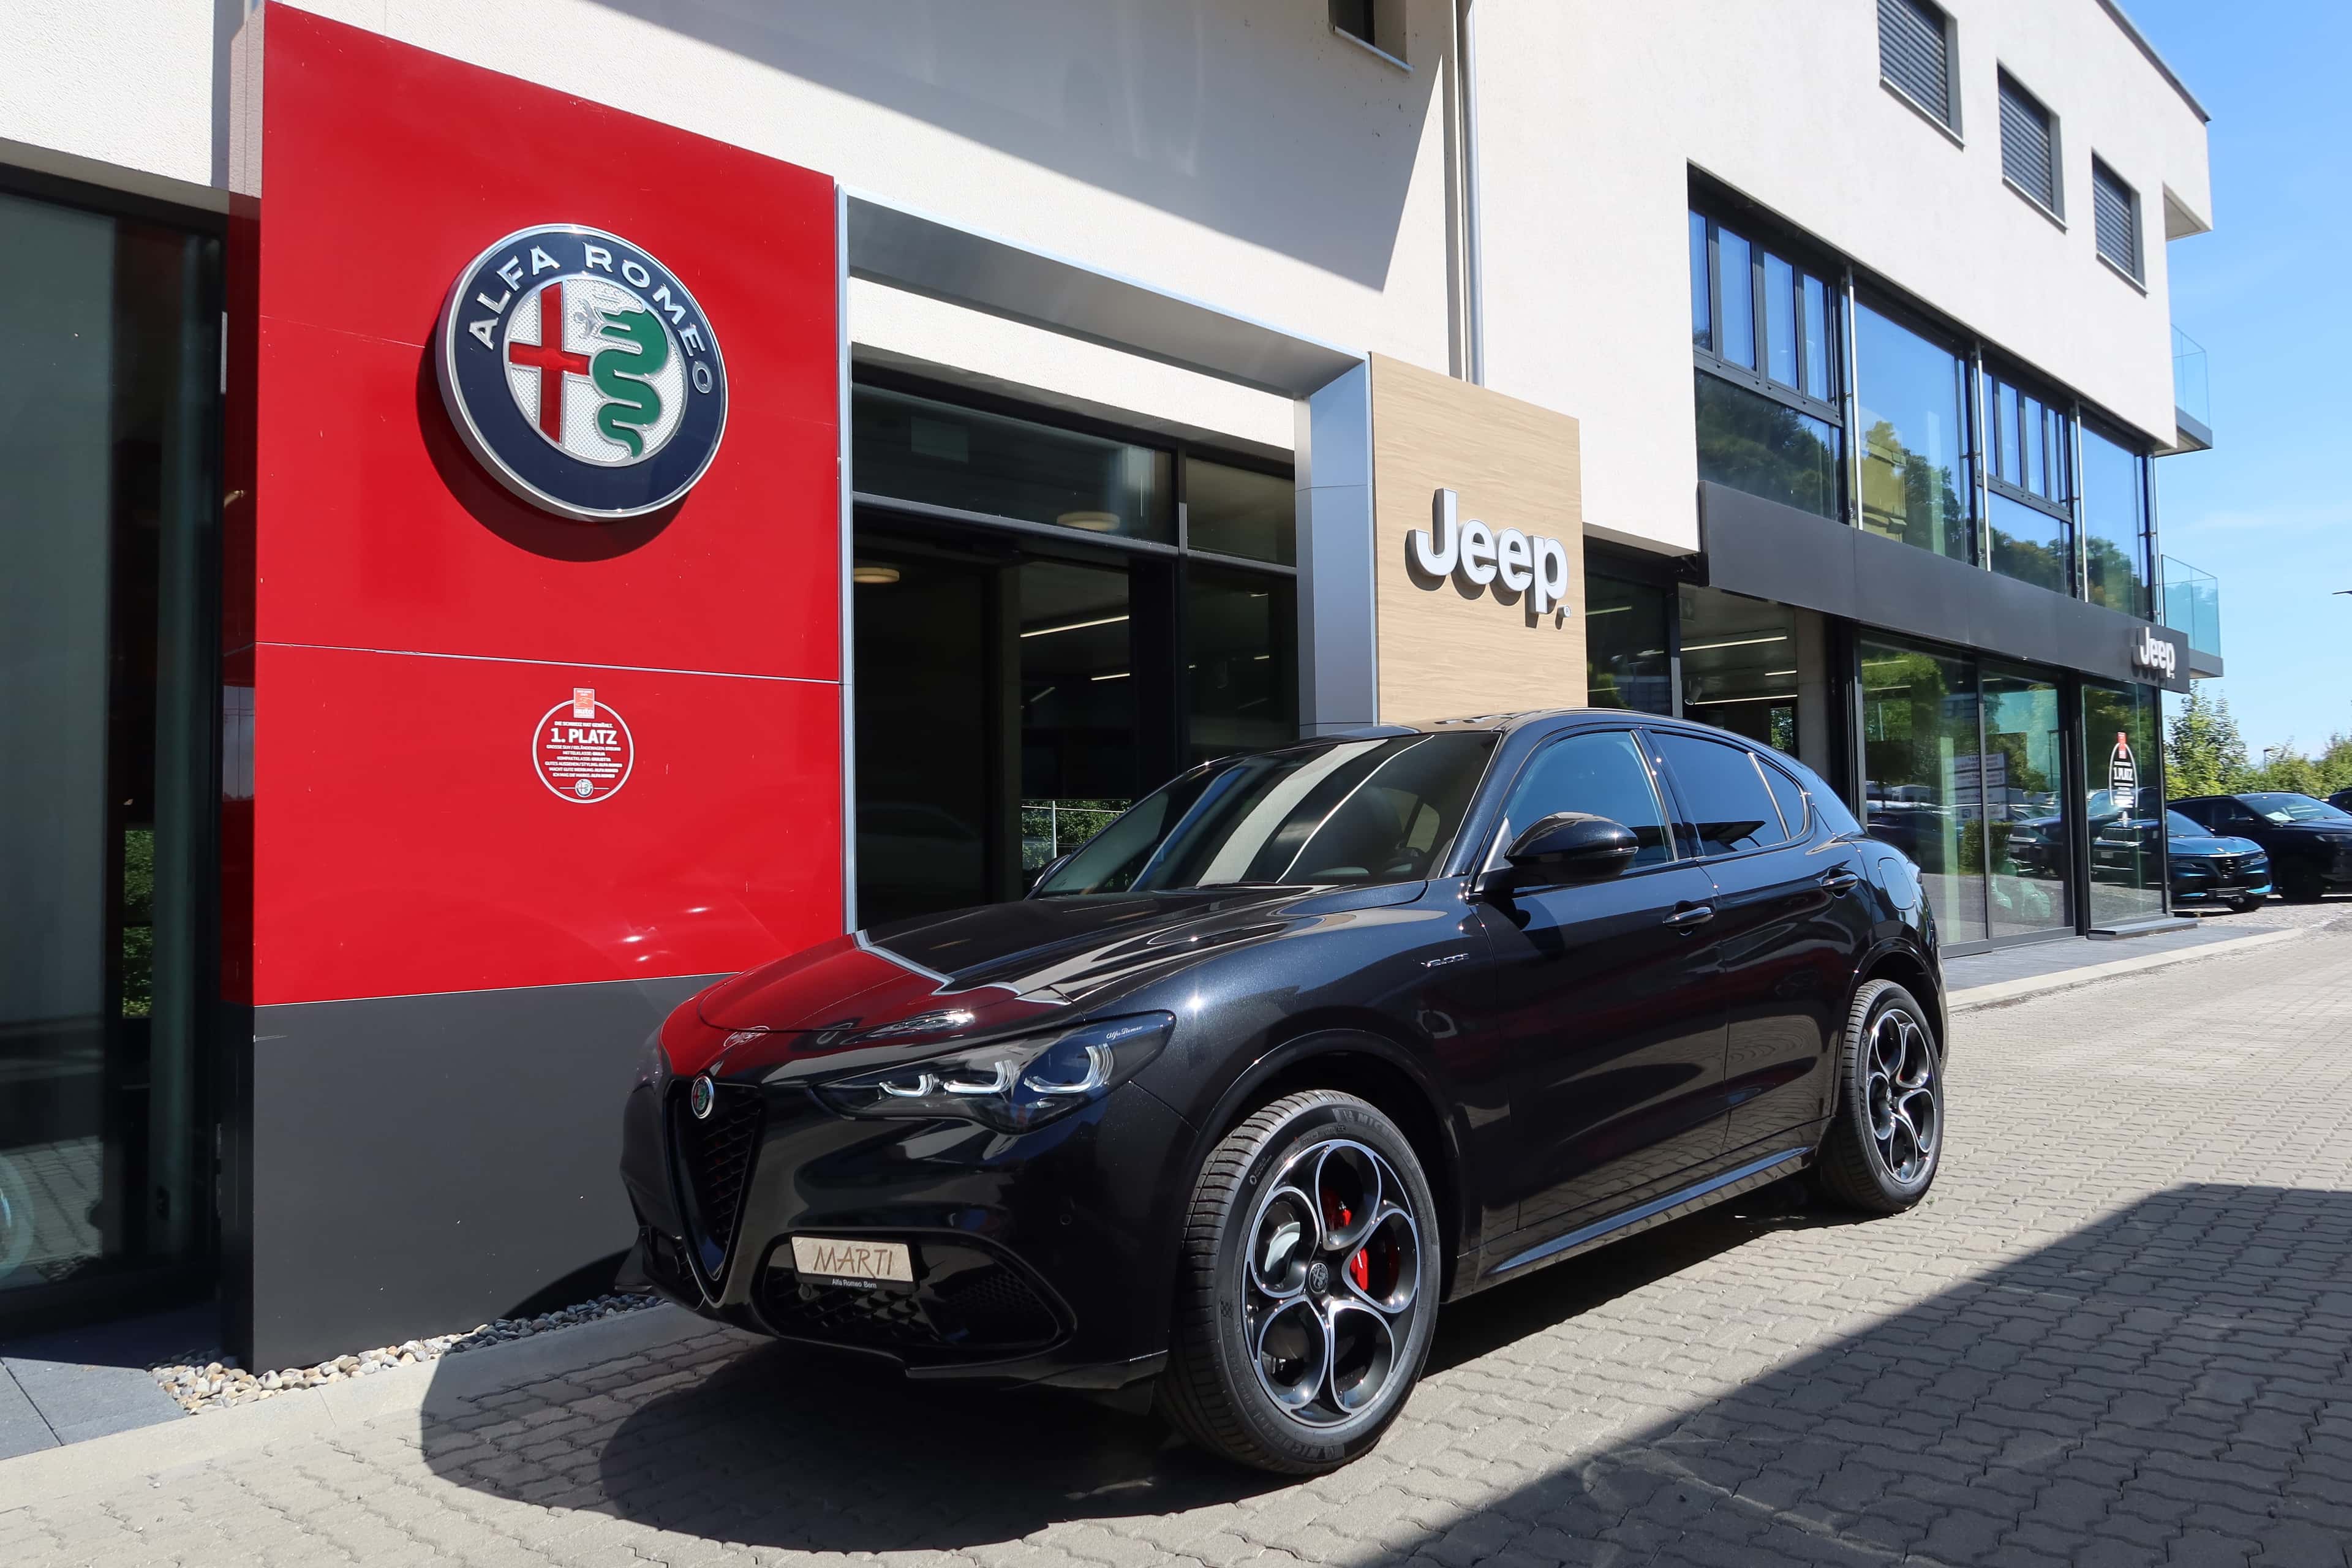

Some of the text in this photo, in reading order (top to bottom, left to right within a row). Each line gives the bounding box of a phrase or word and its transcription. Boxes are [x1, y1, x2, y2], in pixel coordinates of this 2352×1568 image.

[469, 241, 713, 394] ALFA ROMEO
[1405, 488, 1569, 615] Jeep
[2139, 627, 2176, 679] Jeep
[551, 728, 618, 745] 1. PLATZ
[813, 1245, 893, 1279] MARTI
